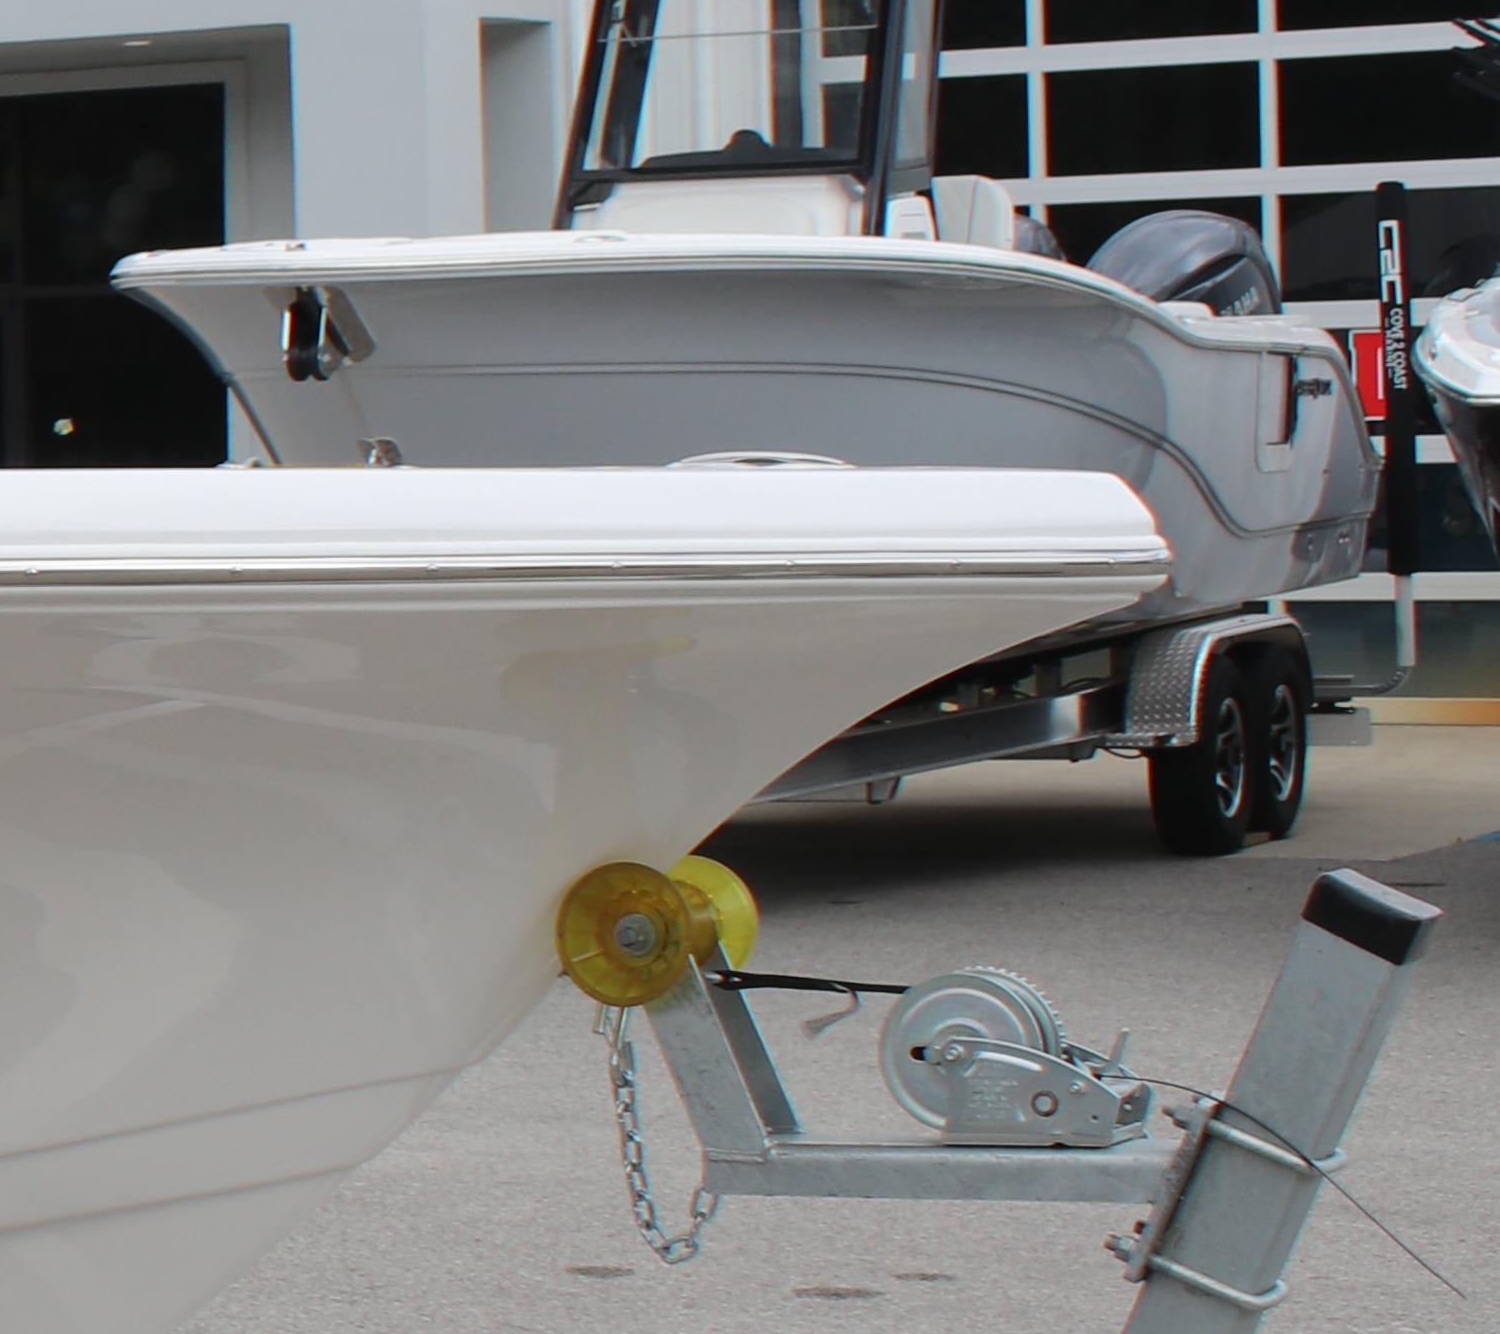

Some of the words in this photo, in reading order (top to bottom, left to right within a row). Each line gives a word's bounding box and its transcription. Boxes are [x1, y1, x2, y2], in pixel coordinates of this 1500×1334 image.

[1379, 220, 1402, 304] C2C
[1390, 308, 1405, 339] COVE
[1393, 351, 1408, 389] COAST
